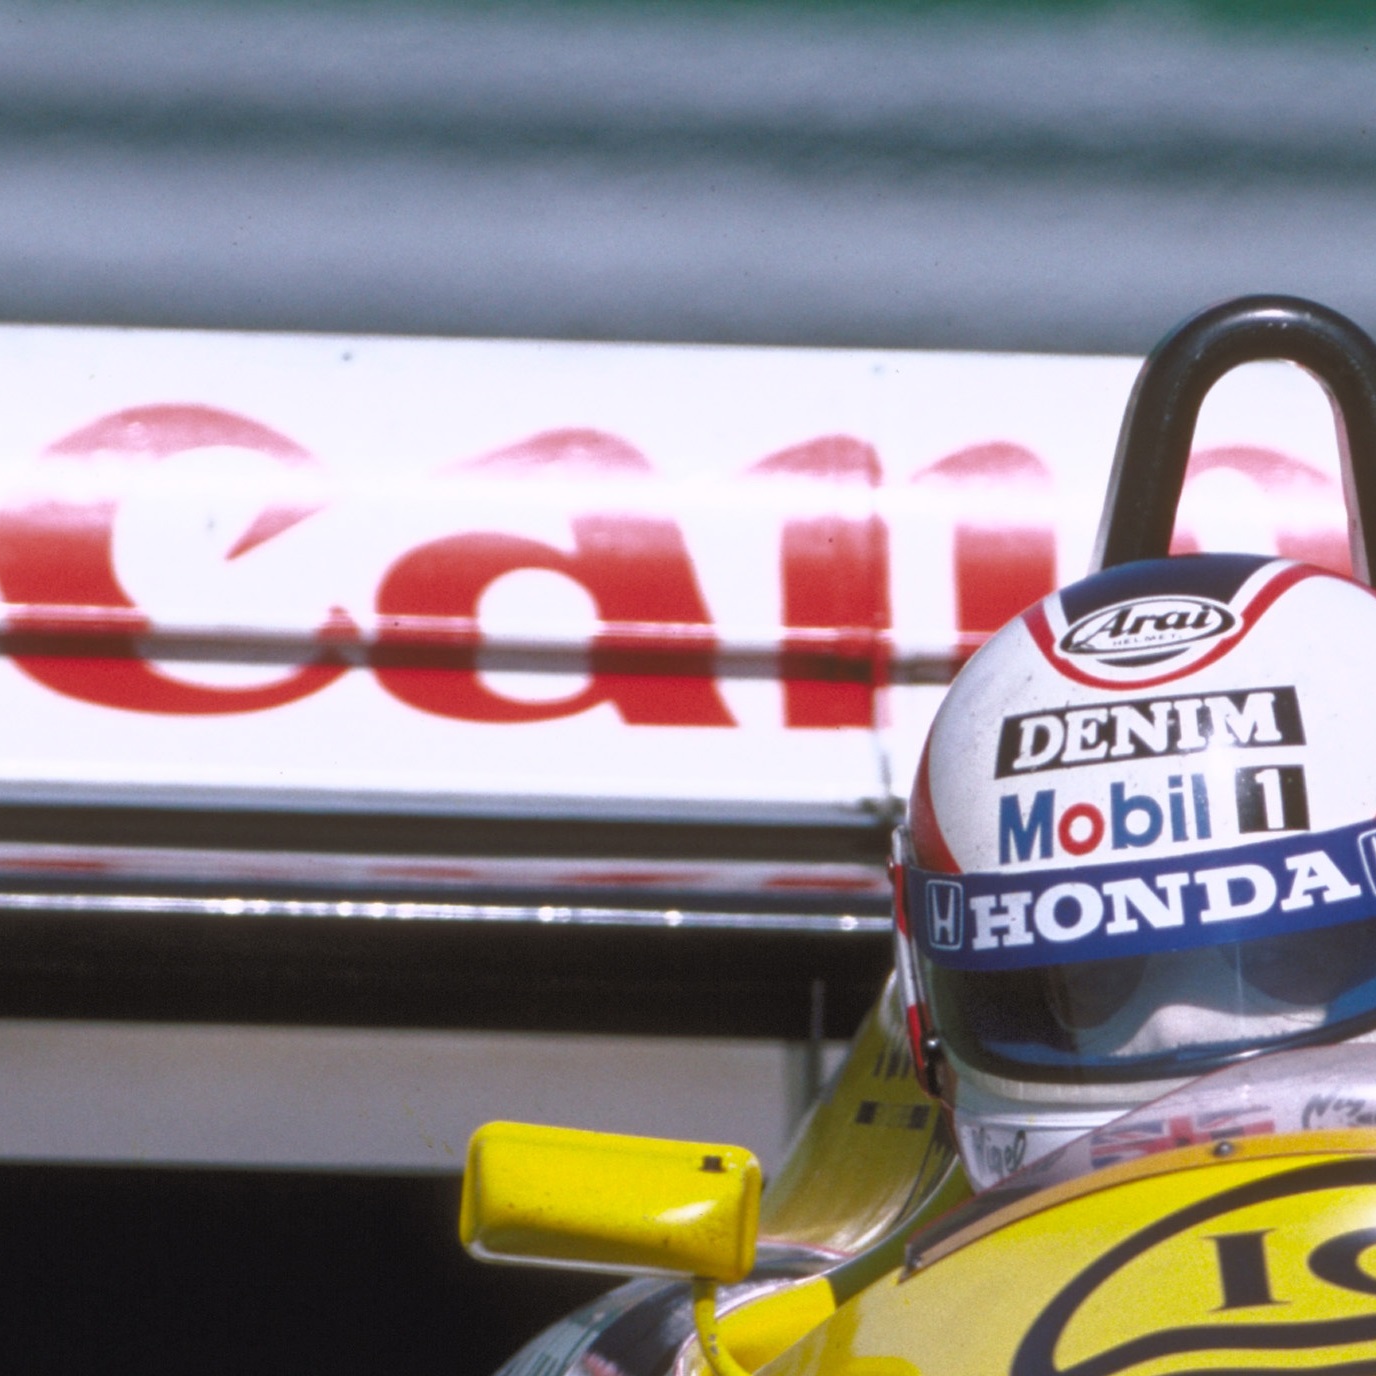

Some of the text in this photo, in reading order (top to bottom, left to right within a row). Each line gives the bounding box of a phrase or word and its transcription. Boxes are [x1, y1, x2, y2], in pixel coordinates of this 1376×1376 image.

[1070, 604, 1214, 650] Arai
[1012, 691, 1284, 771] DENIM
[998, 769, 1288, 865] Mobil 1
[970, 850, 1362, 951] HONDA
